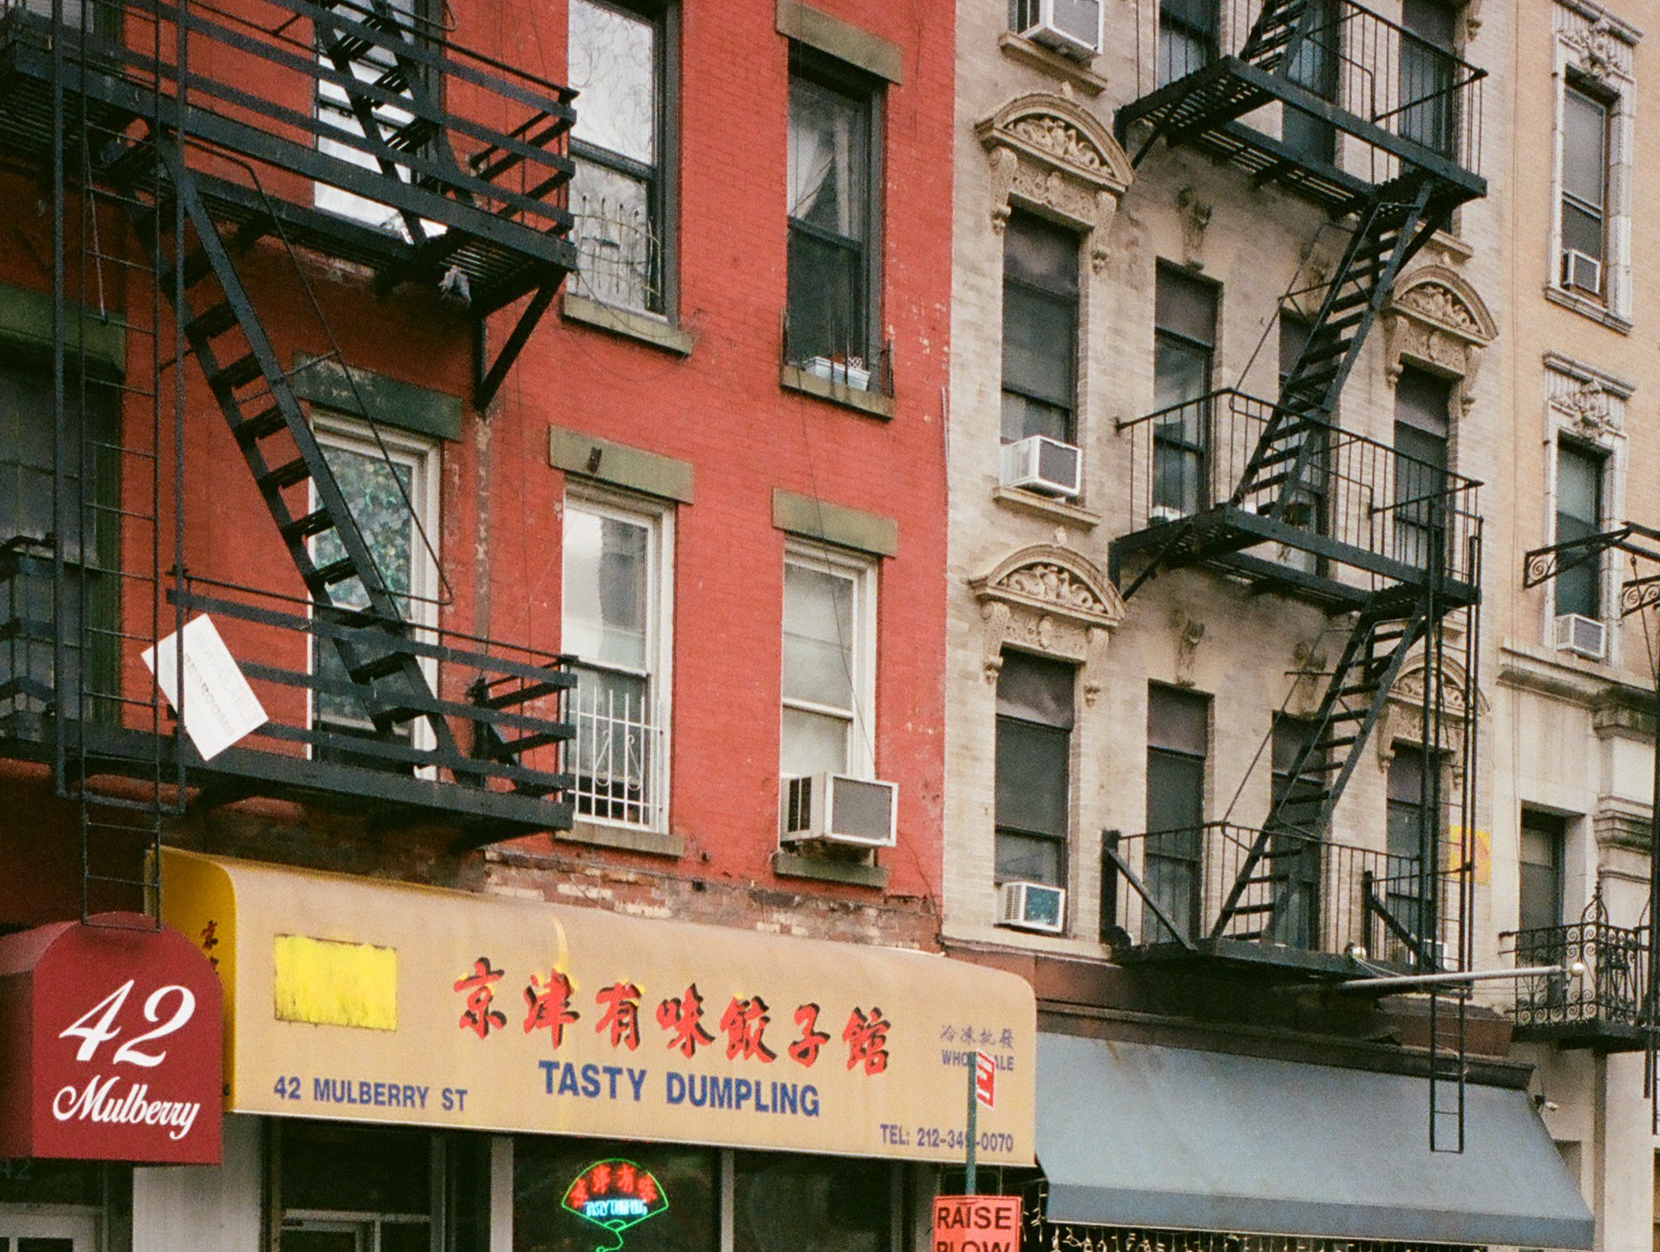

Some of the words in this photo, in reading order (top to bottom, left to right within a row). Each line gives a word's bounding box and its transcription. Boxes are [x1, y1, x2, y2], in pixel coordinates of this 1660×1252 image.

[58, 979, 196, 1068] 42
[453, 956, 892, 1076] 京津有味餃子館
[53, 1074, 201, 1140] Mulberry
[273, 1076, 301, 1100] 42
[313, 1077, 430, 1109] MULBERRY
[441, 1087, 468, 1112] ST
[538, 1059, 647, 1102] TASTY
[666, 1071, 820, 1117] DUMPLING
[880, 1124, 910, 1146] TEL:
[937, 1206, 1012, 1230] RAISE
